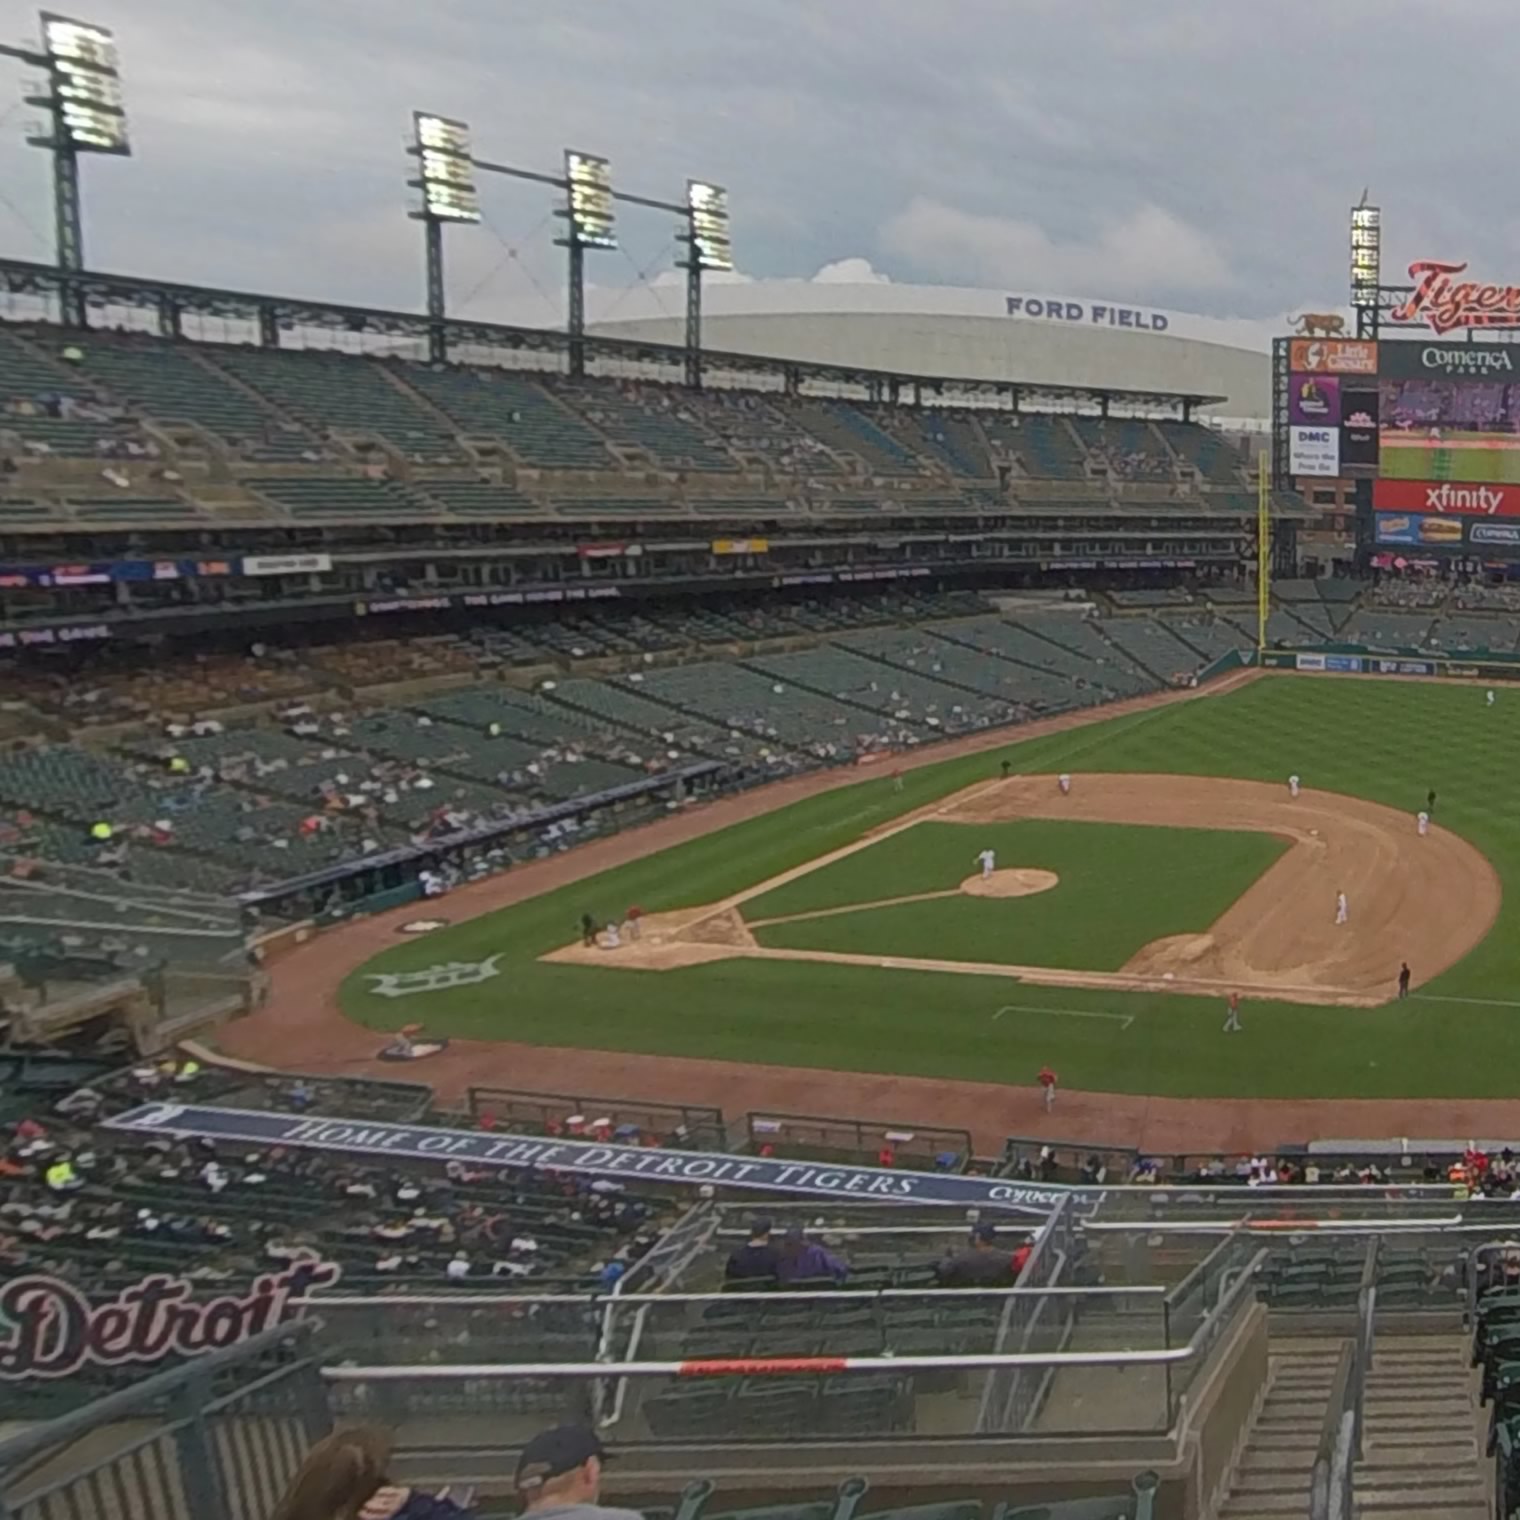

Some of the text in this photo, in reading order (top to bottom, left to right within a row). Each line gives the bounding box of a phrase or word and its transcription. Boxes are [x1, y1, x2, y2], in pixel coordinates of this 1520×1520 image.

[1005, 297, 1168, 331] FORD FIELD
[1298, 431, 1330, 443] DMC
[1425, 483, 1504, 514] xfinity
[281, 1119, 920, 1195] HOME OF THE DETROIT TIGERS
[0, 1261, 342, 1379] Detroit
